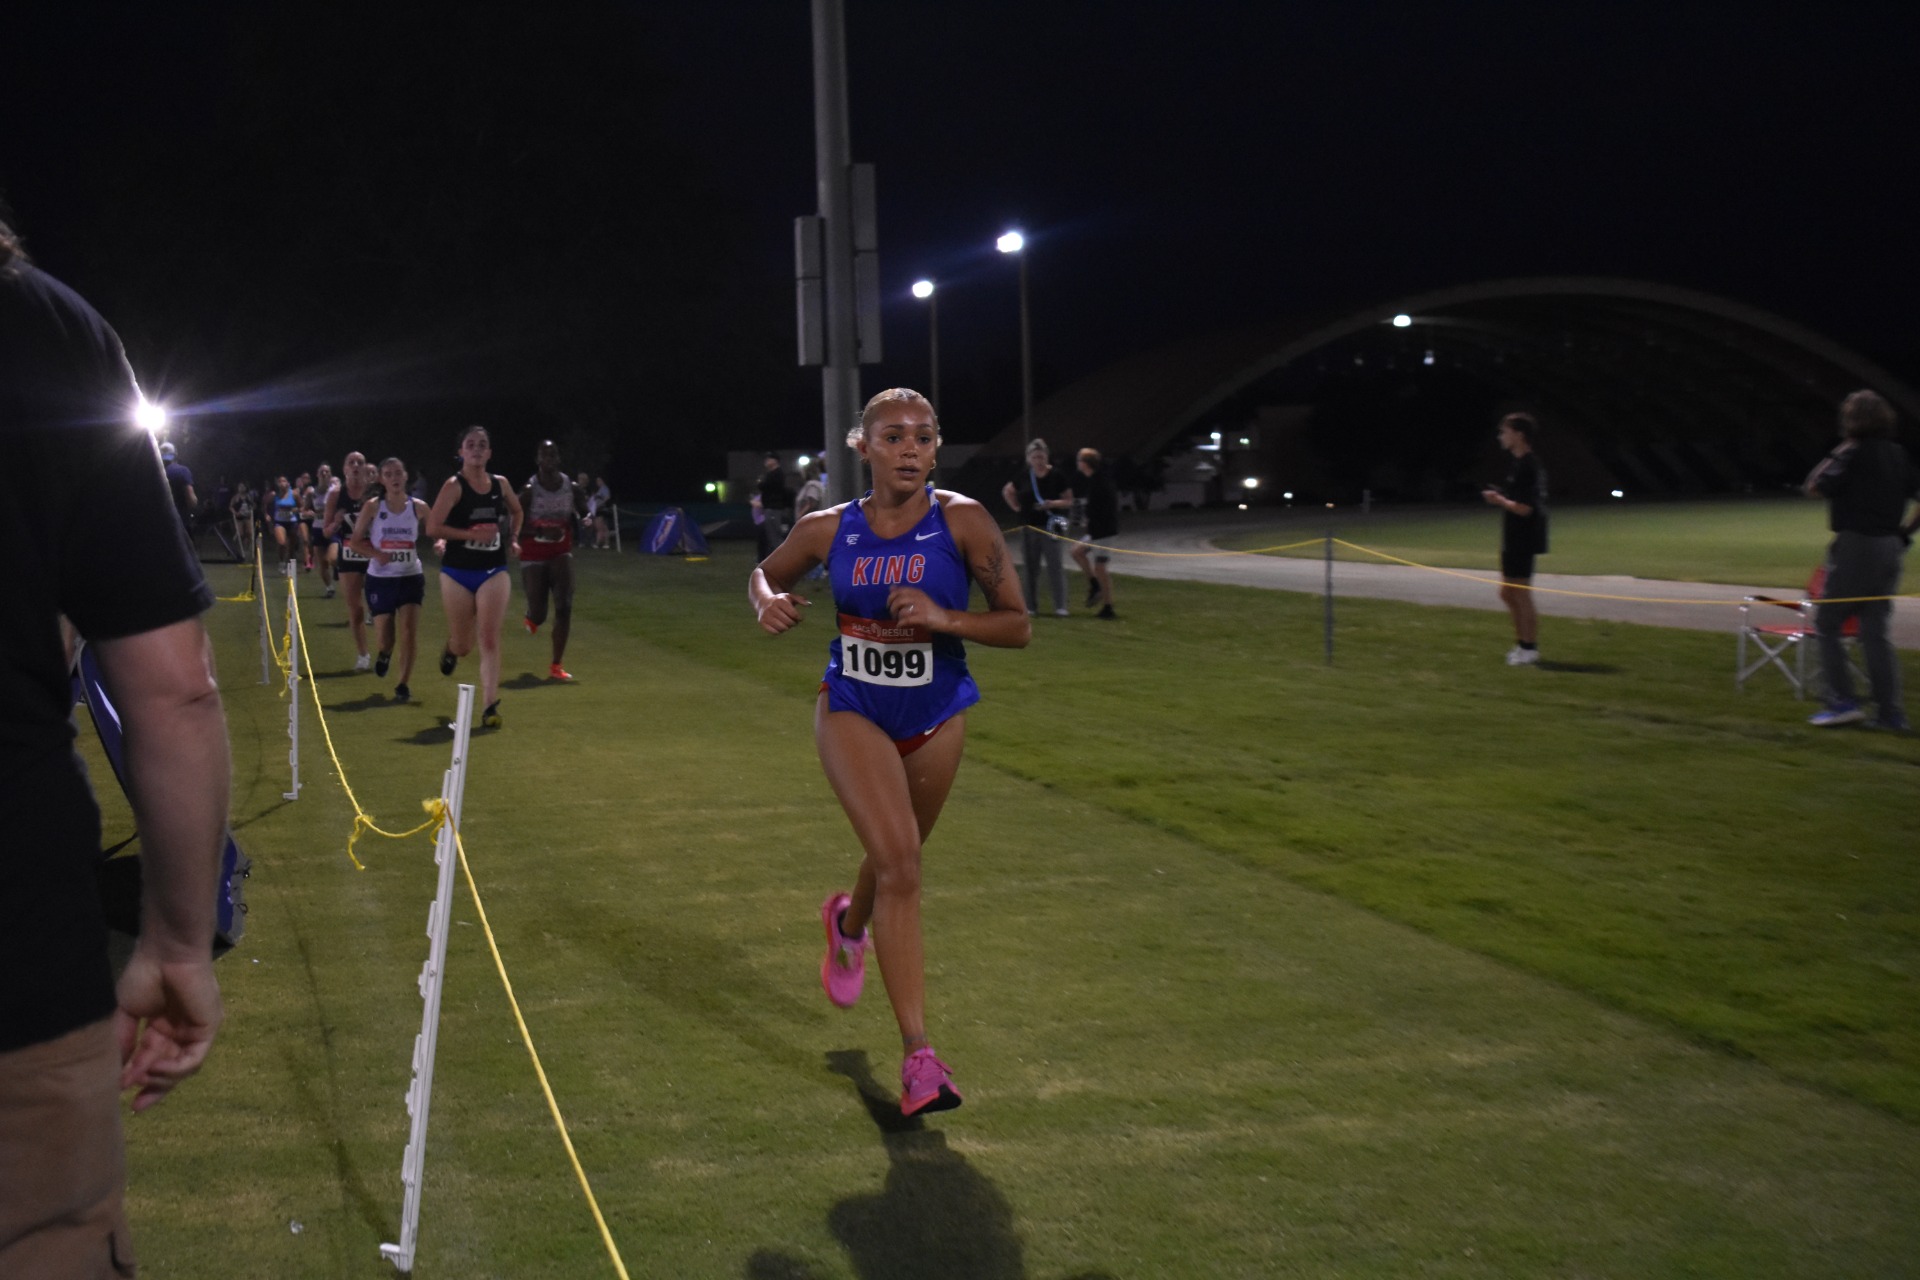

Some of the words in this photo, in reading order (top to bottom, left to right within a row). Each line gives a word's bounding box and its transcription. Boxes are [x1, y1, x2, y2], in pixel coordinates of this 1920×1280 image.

[852, 554, 926, 586] KING
[882, 628, 914, 638] RESULT
[847, 644, 925, 679] 1099
